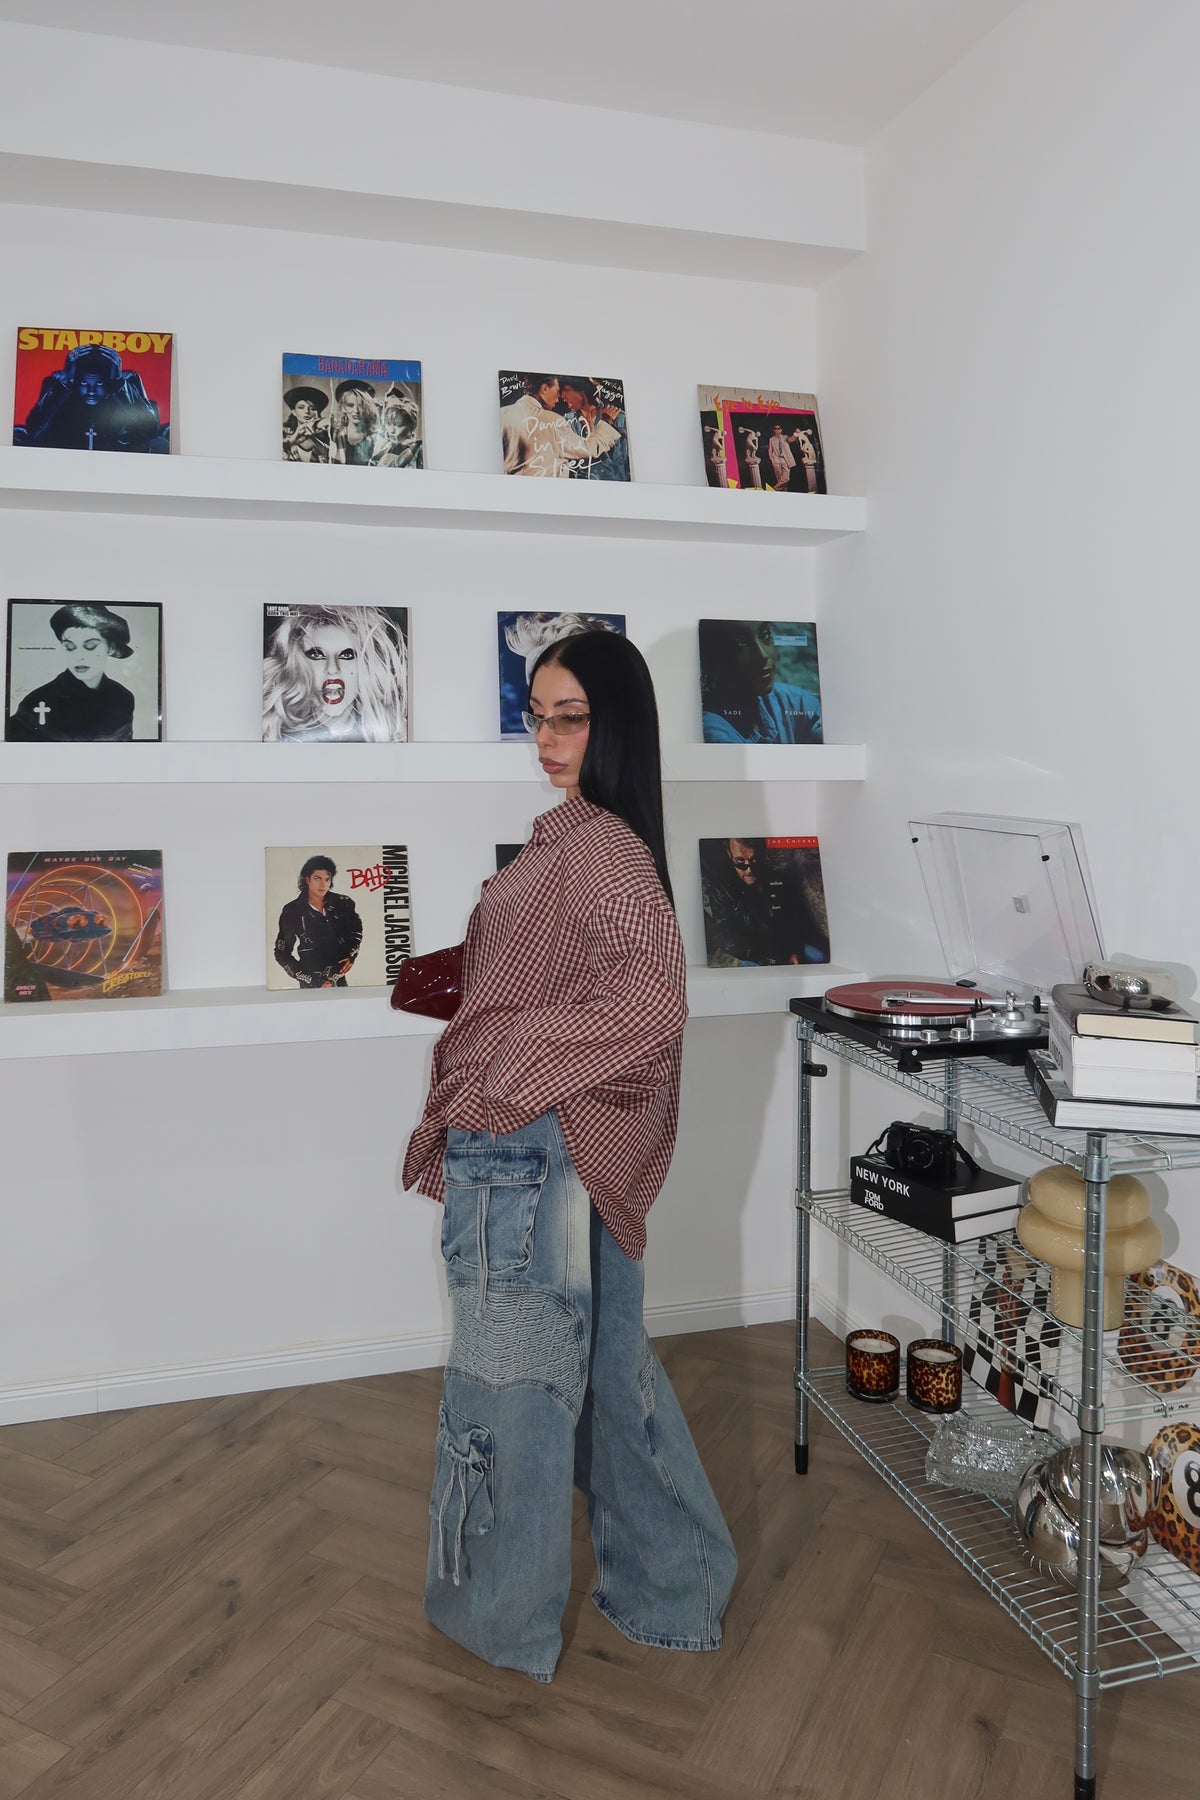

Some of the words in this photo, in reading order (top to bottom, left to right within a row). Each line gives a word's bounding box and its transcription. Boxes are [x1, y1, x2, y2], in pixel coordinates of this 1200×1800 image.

[18, 328, 171, 354] STARBOY
[318, 356, 389, 378] BANANARAMA
[523, 416, 591, 441] Dancing
[346, 863, 392, 892] BAD
[382, 845, 410, 913] MICHAEL
[855, 1165, 879, 1185] NEW
[881, 1175, 911, 1198] YORK
[864, 1189, 881, 1203] TOM
[864, 1197, 885, 1211] FORD
